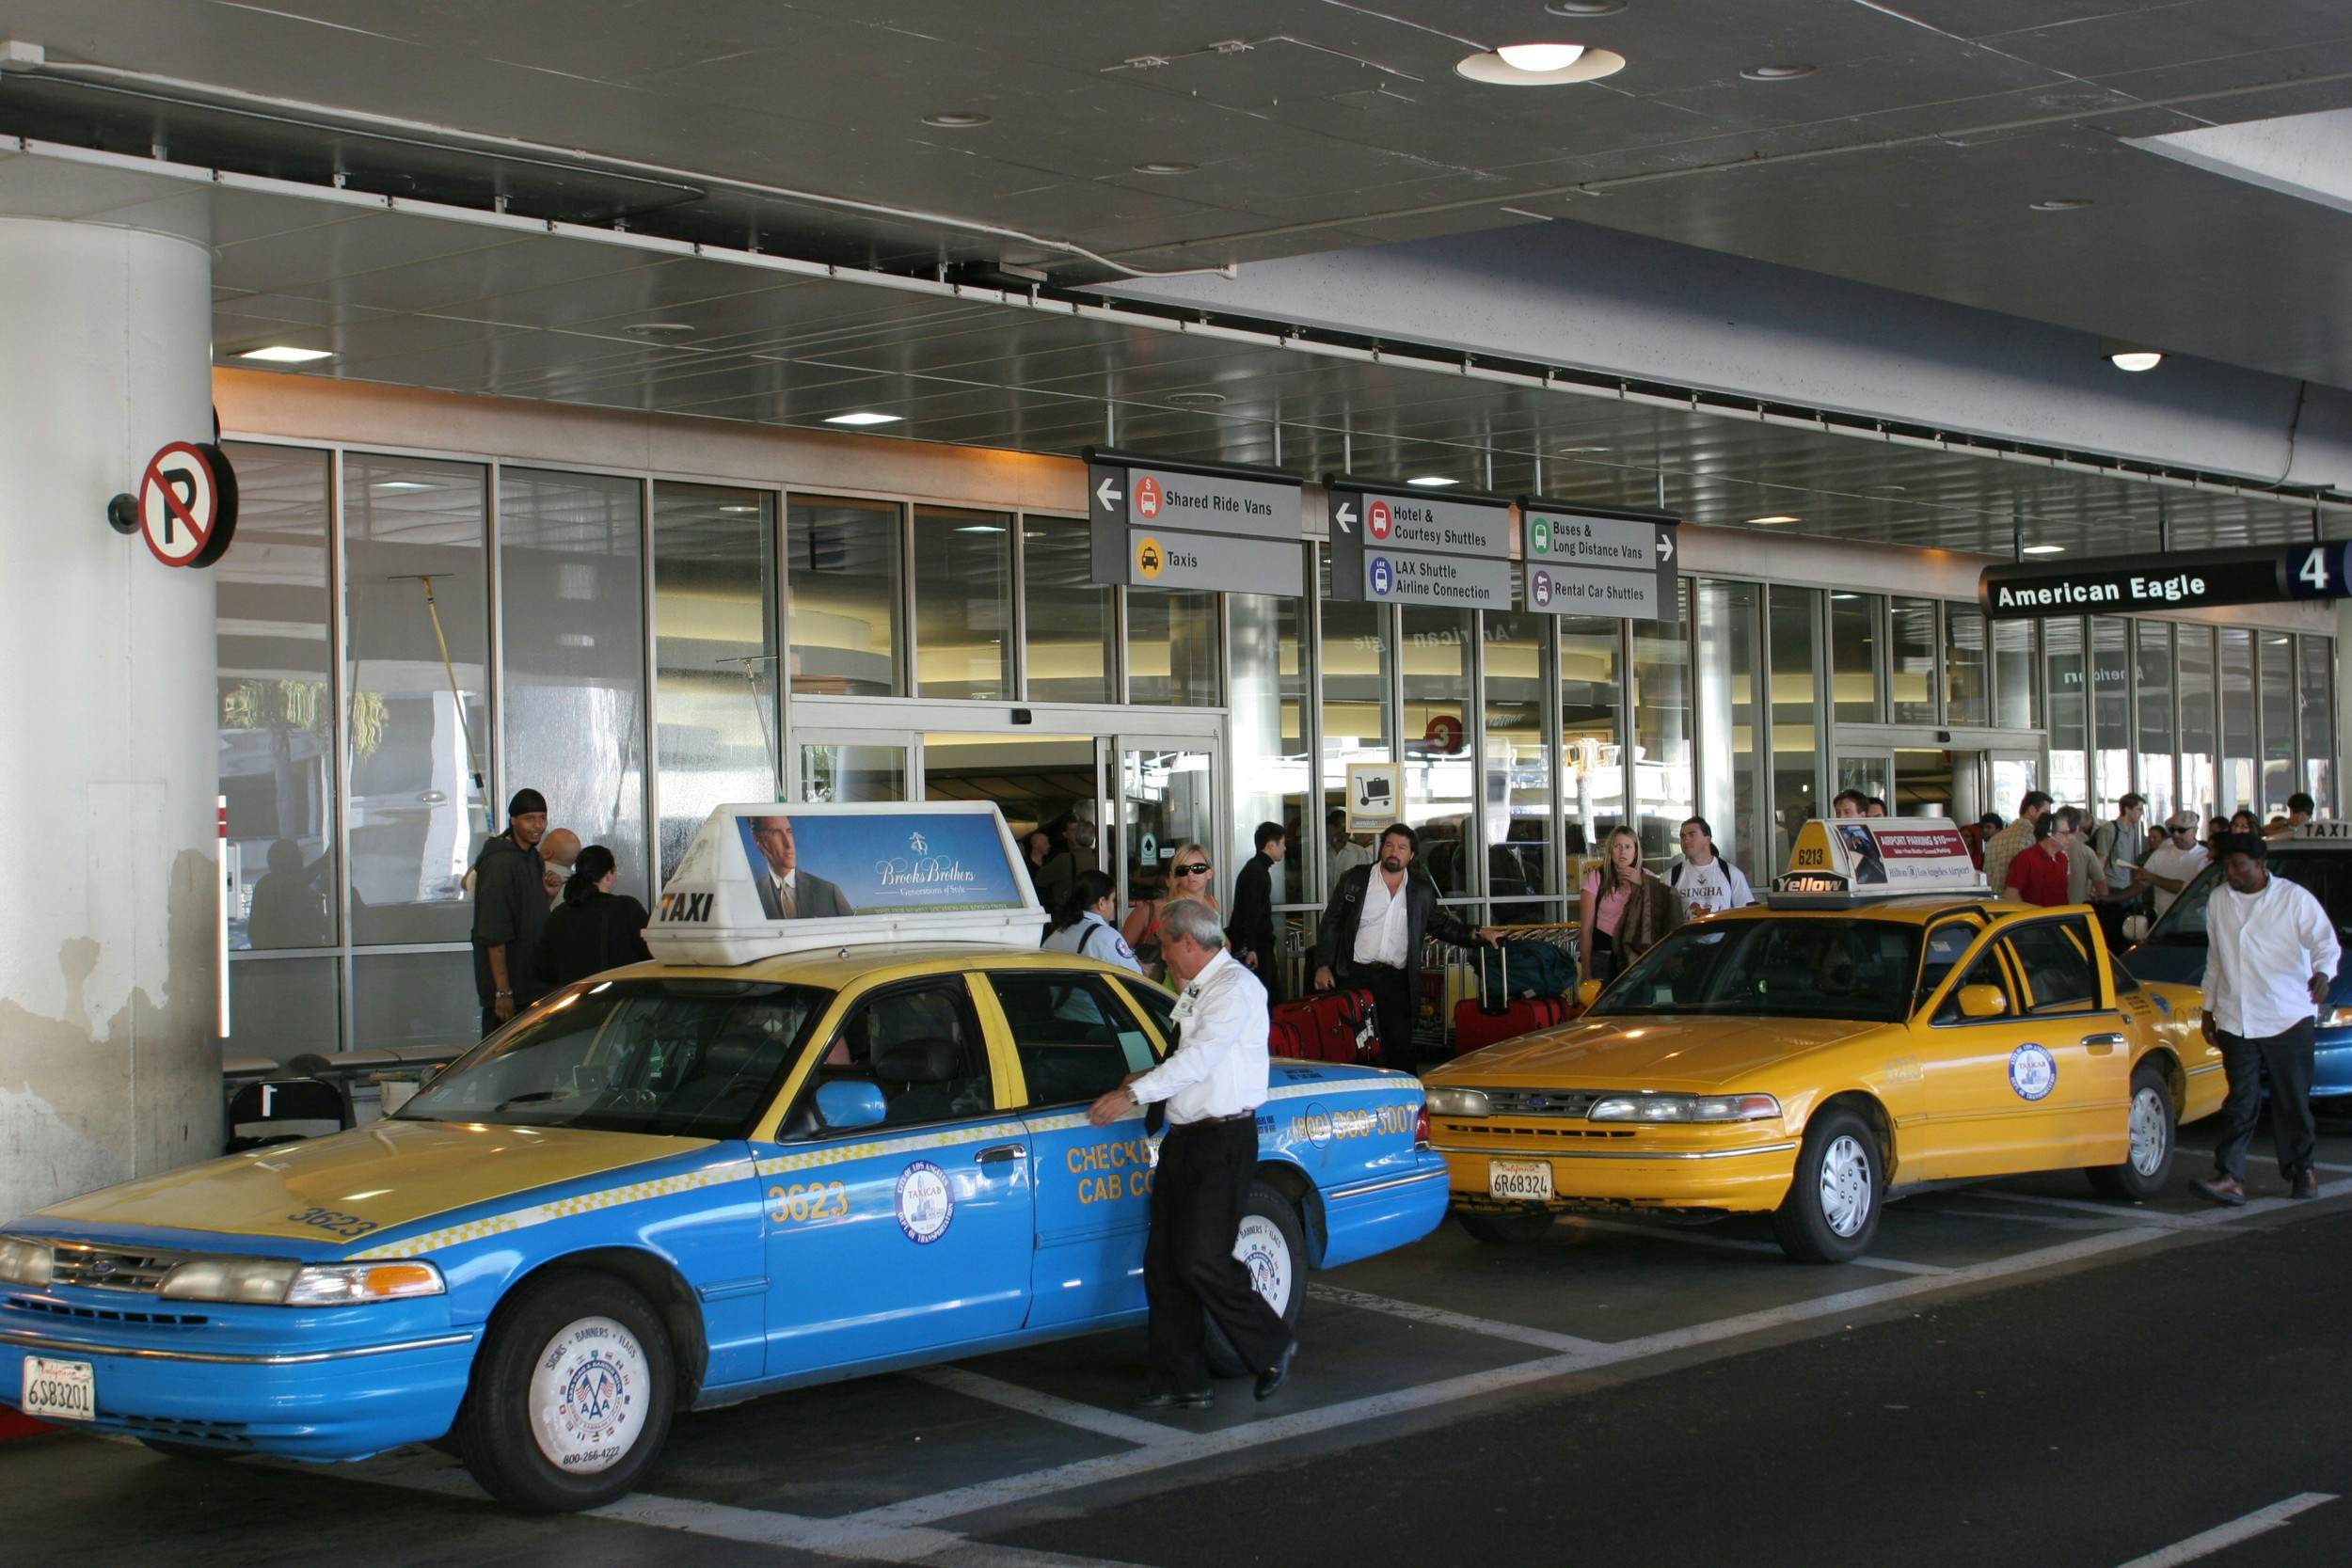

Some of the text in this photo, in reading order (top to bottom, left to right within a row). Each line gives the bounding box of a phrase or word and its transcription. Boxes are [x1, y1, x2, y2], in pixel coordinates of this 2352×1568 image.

[1166, 490, 1272, 516] Shared Ride Vans
[1394, 506, 1433, 523] Hotel &
[1395, 525, 1486, 546] Courtesy Shuttles
[1553, 522, 1592, 537] Buses &
[1553, 539, 1643, 559] Long Distance Vans
[1167, 551, 1198, 568] Taxis
[2298, 546, 2329, 590] 4
[1395, 561, 1457, 579] LAX Shuttle
[1396, 580, 1490, 600] Airline Connection
[1555, 581, 1644, 601] Rental Car Shuttles
[1998, 573, 2206, 608] American Eagle
[1434, 723, 1449, 747] 3
[1881, 836, 1906, 846] AIRPORT
[1906, 836, 1933, 846] PARKING
[1933, 835, 1947, 845] $10
[2304, 824, 2348, 837] TAXI
[1798, 848, 1823, 865] 6213
[876, 855, 975, 886] Brooks Brothers
[1679, 887, 1723, 898] SINGHA
[1778, 877, 1842, 892] Yellow
[660, 893, 714, 922] TAXI
[1067, 1137, 1151, 1174] CHECKE
[912, 1162, 924, 1171] LOS
[907, 1187, 941, 1199] TAXICAB
[1078, 1174, 1122, 1204] CAB
[1494, 1174, 1547, 1195] 6R68324
[767, 1180, 849, 1222] 3623
[287, 1207, 378, 1235] 3623
[546, 1327, 636, 1370] SIGNS BANNERS FLAGS
[29, 1379, 89, 1411] 6S83201
[563, 1446, 621, 1465] 800-266-4222
